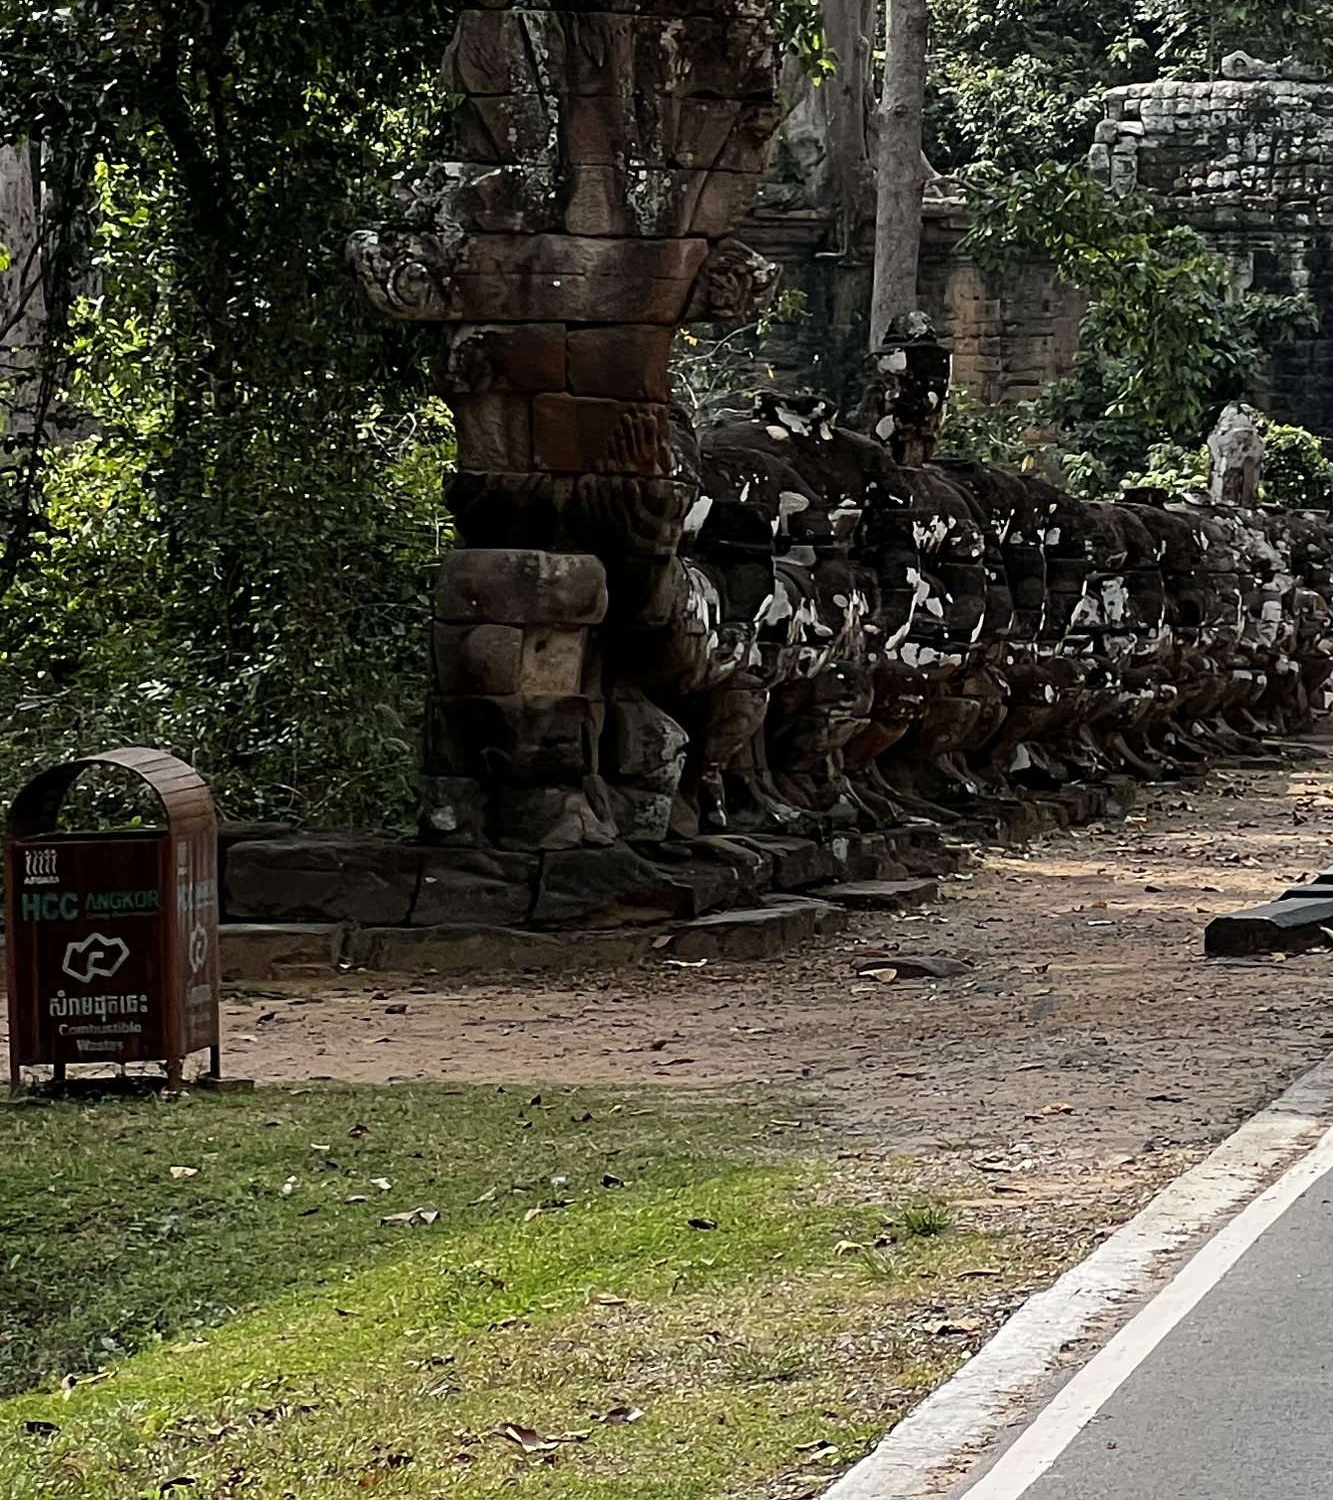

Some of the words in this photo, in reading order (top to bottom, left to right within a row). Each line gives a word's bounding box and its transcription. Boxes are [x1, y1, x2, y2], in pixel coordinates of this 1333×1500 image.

[22, 892, 78, 921] HCC
[85, 890, 160, 910] ANGKOR
[59, 1022, 142, 1036] Combustible
